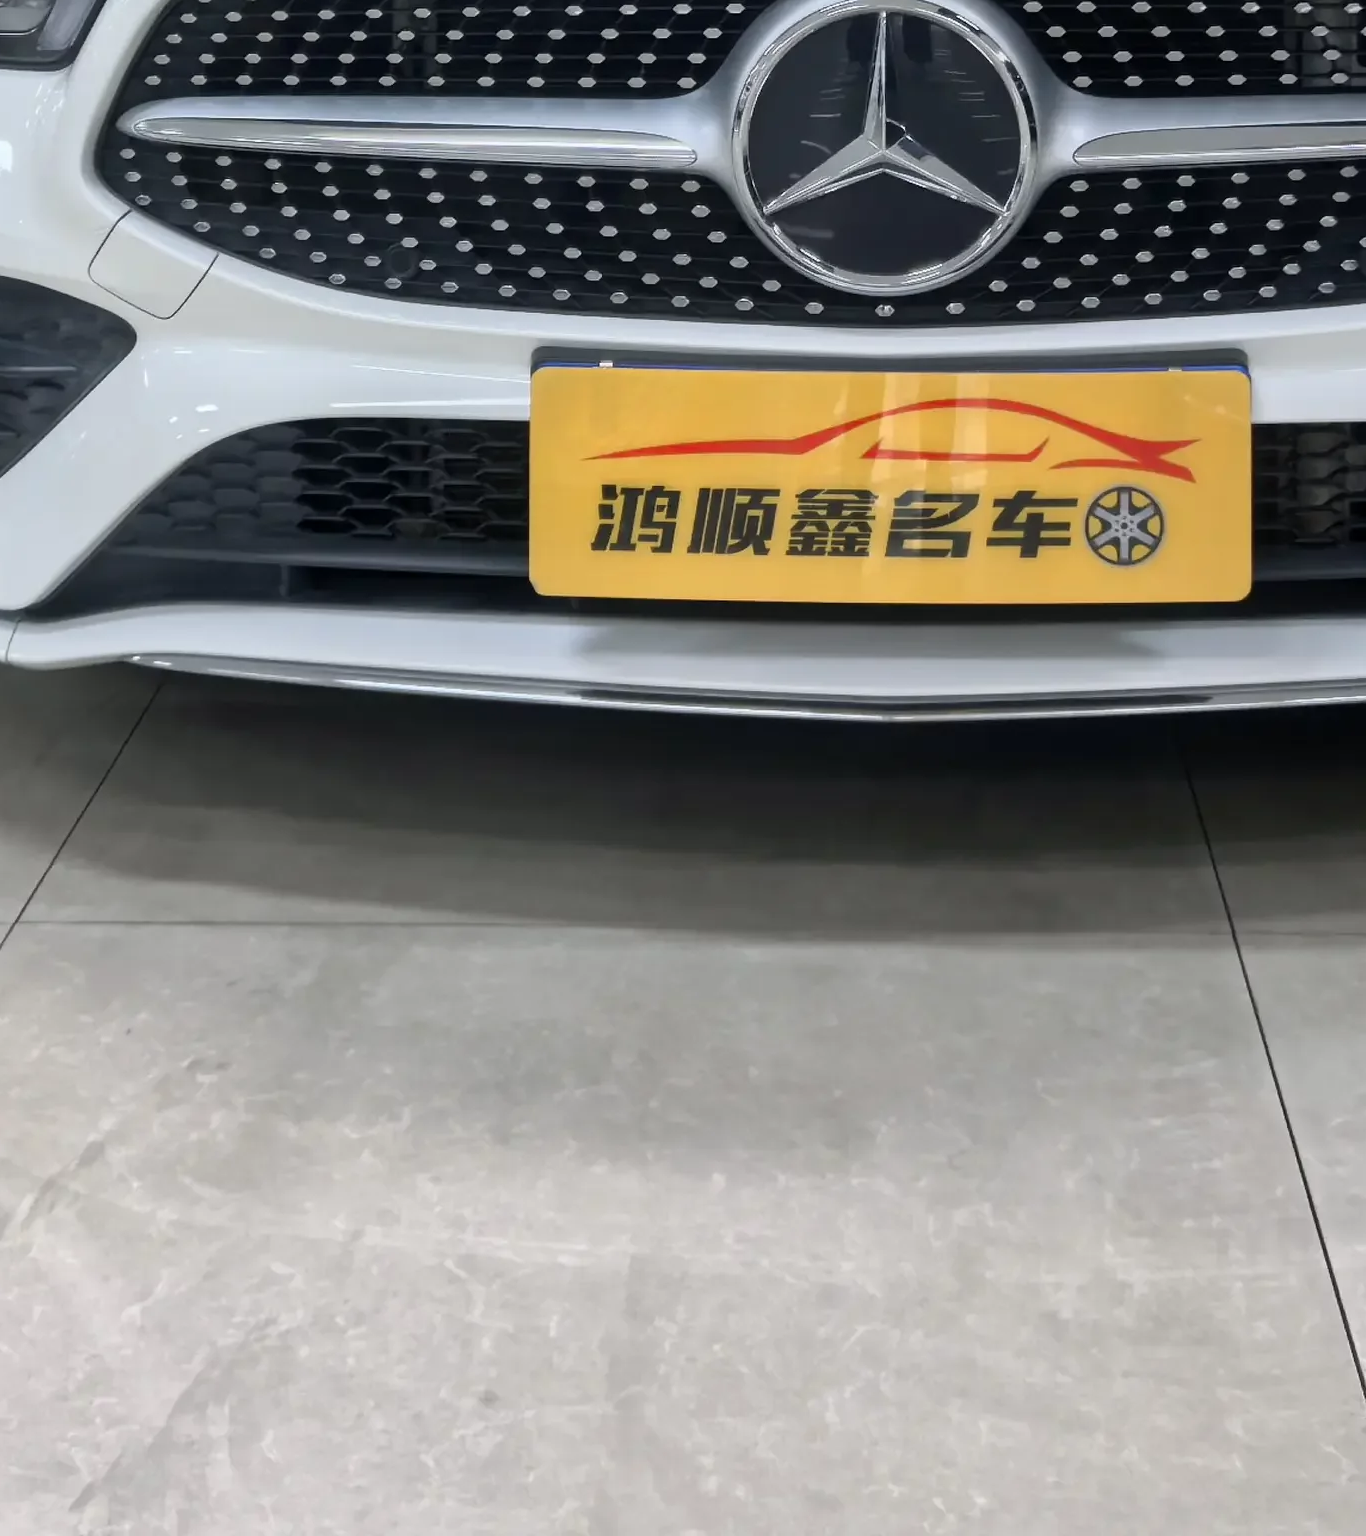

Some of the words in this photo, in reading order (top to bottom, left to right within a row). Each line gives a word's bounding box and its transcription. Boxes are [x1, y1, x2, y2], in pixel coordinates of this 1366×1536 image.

[589, 483, 1079, 561] 鸿顺鑫名车
